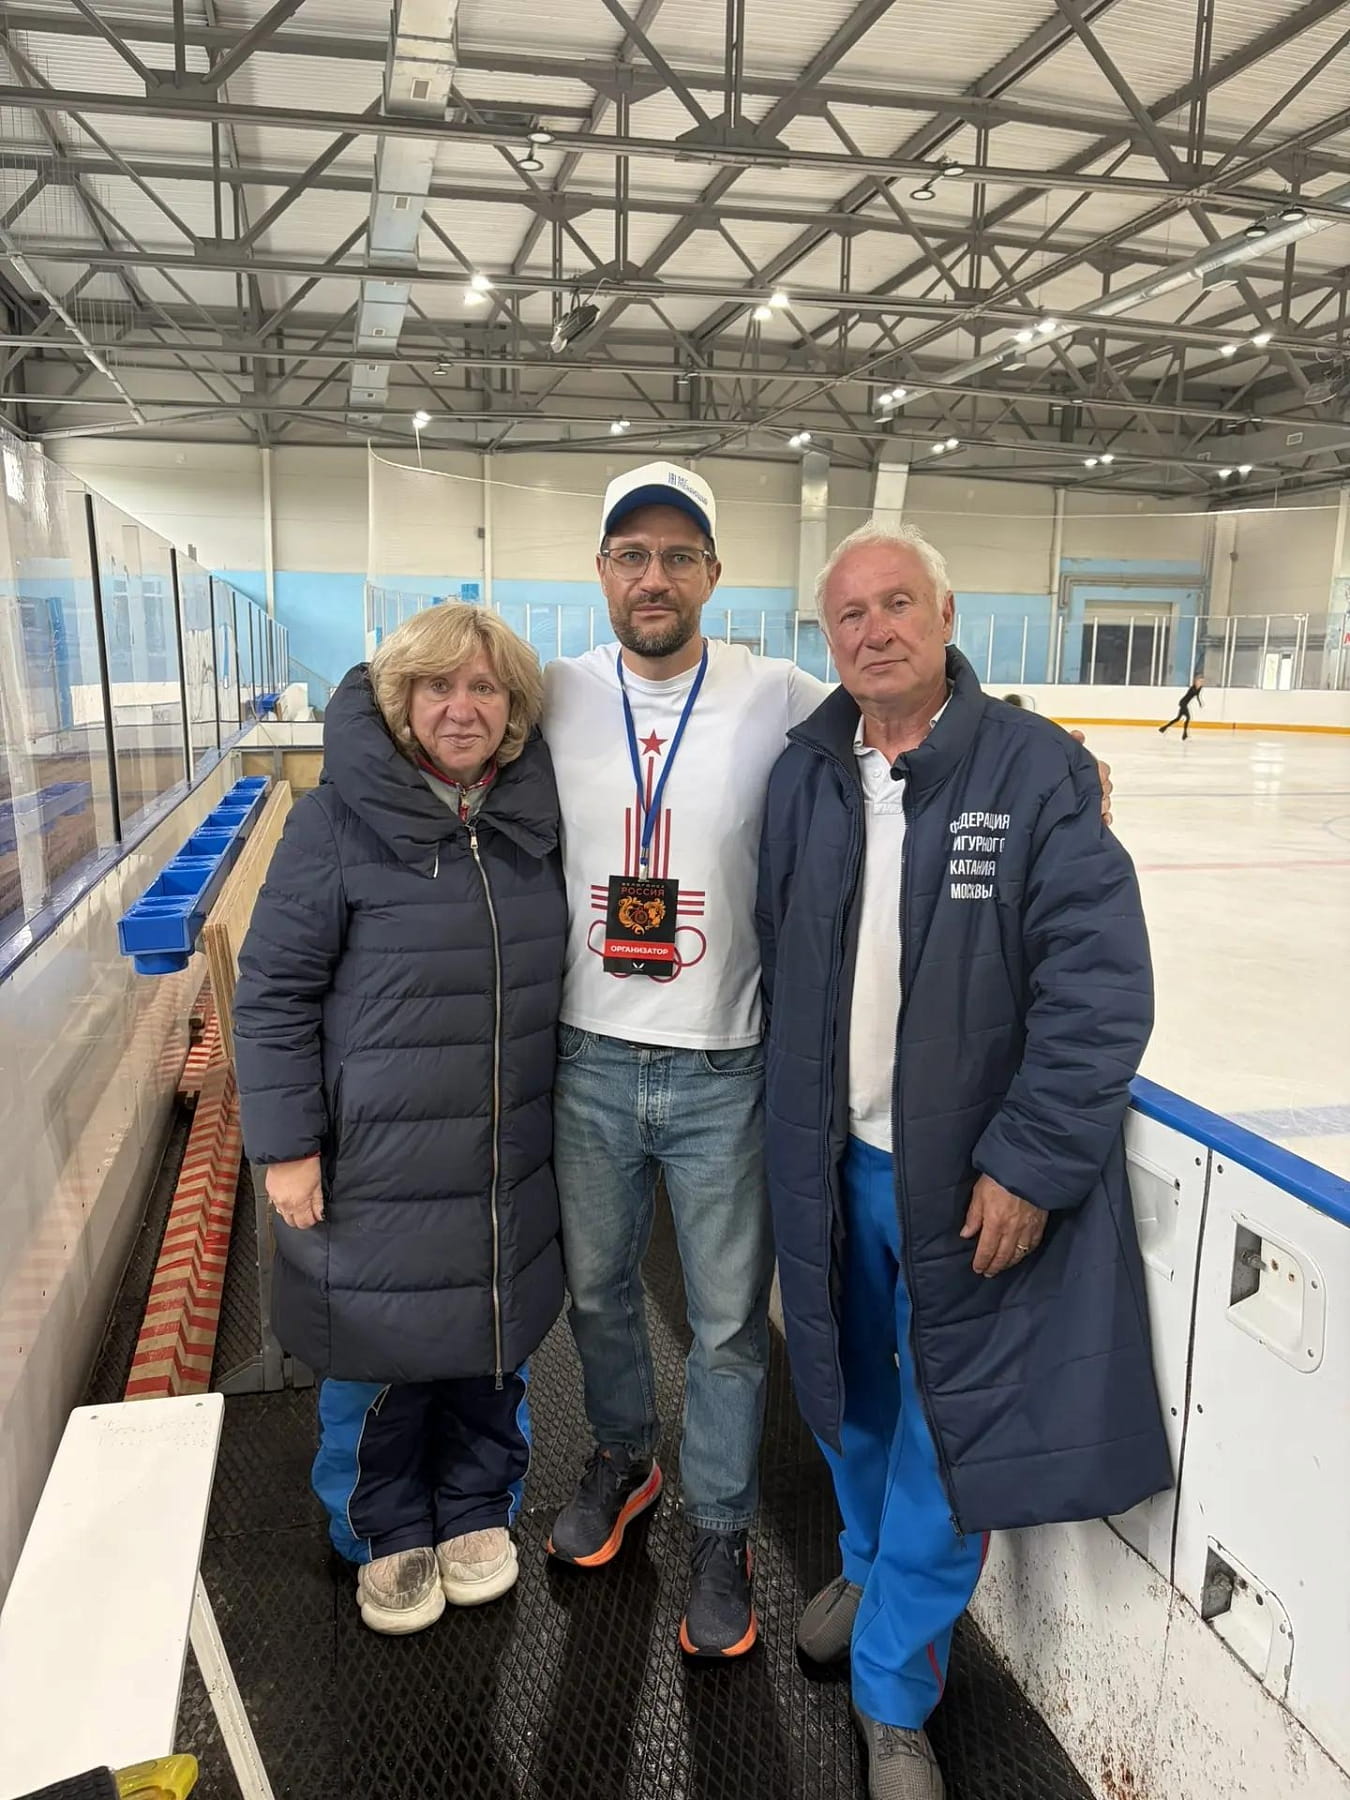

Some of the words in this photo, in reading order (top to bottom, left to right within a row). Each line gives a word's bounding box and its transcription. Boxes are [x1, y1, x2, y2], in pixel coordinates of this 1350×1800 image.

[953, 836, 1006, 853] ИГУРНОГ
[950, 859, 996, 876] КАТАНИЯ
[621, 887, 665, 897] РОССИЯ
[610, 945, 669, 956] ОРГАНИЗАТОР
